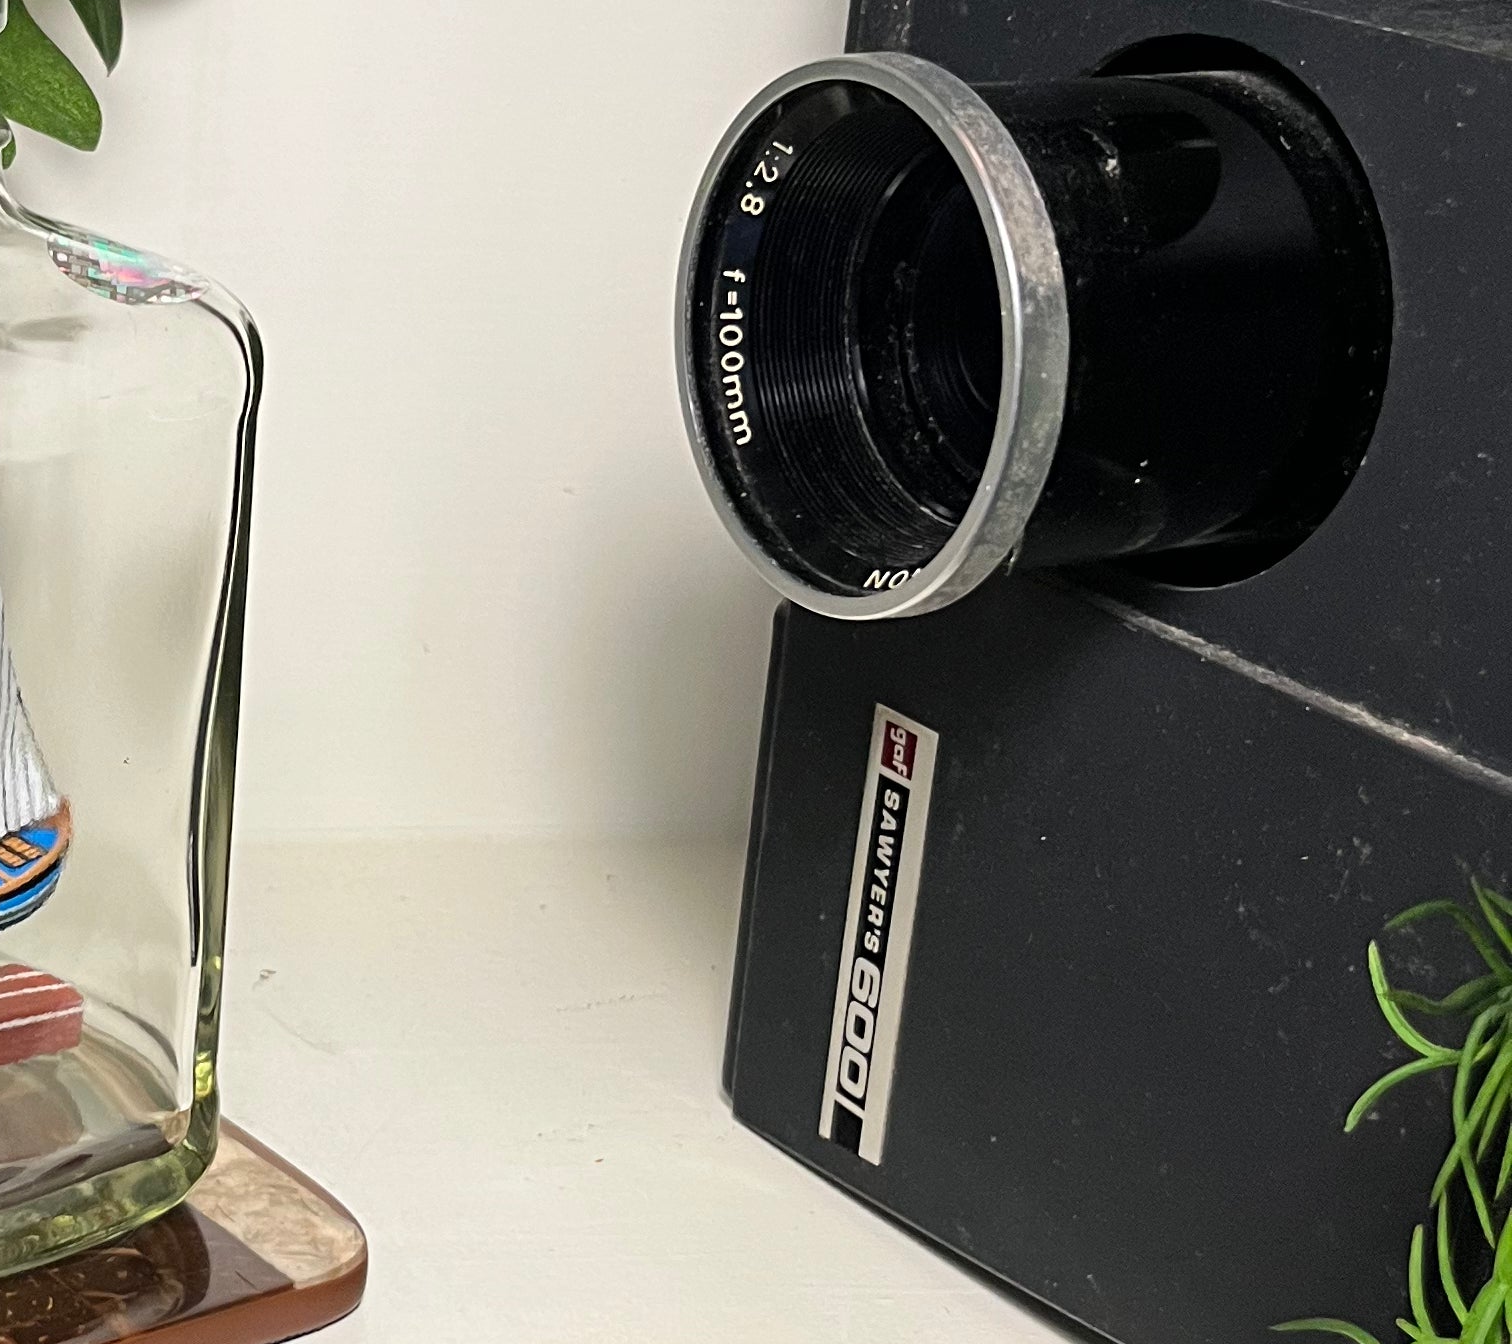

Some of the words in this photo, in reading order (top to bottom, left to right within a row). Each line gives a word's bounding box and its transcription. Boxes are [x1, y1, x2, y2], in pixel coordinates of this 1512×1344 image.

[740, 141, 793, 216] 1:2.8
[890, 727, 908, 777] gaf
[864, 788, 900, 954] SAWYER'S
[839, 956, 881, 1099] 600
